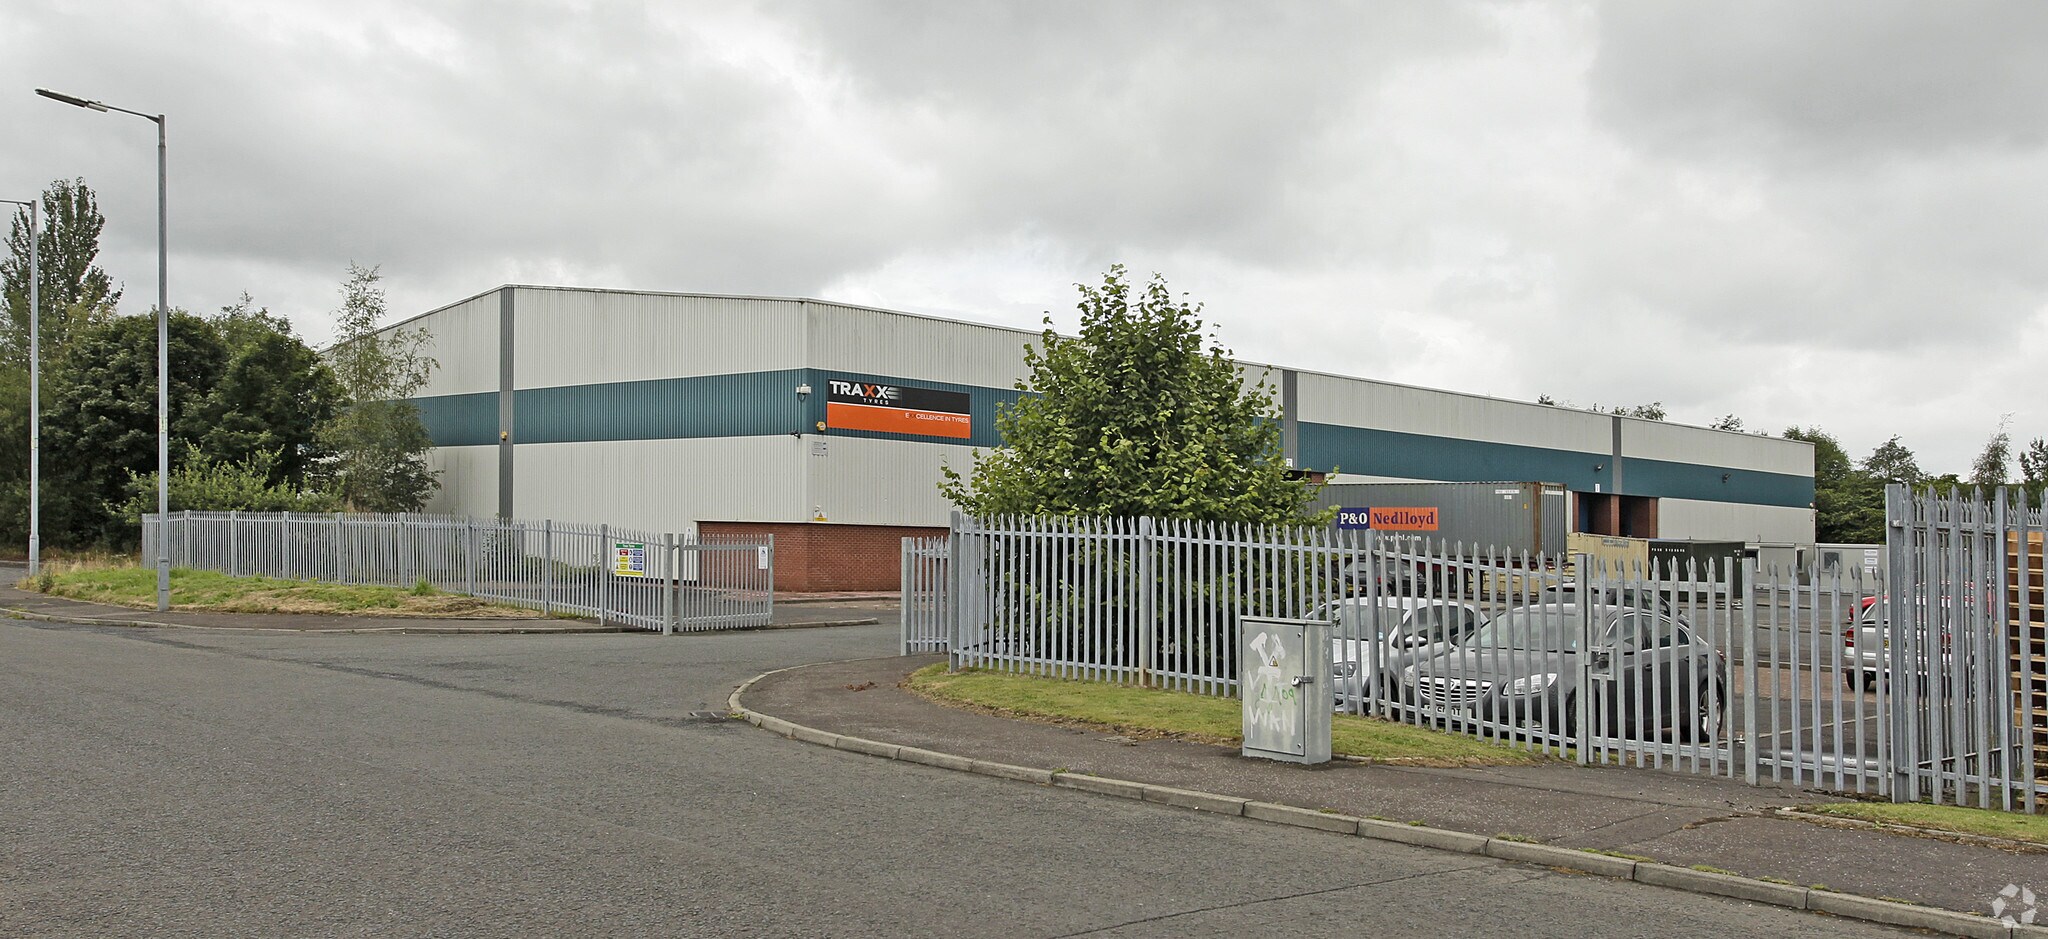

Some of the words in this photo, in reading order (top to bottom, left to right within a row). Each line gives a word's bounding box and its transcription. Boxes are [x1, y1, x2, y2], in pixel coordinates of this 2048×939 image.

[829, 381, 889, 399] TRAXX
[1340, 512, 1368, 524] P&O
[1373, 512, 1435, 528] Nedlloyd
